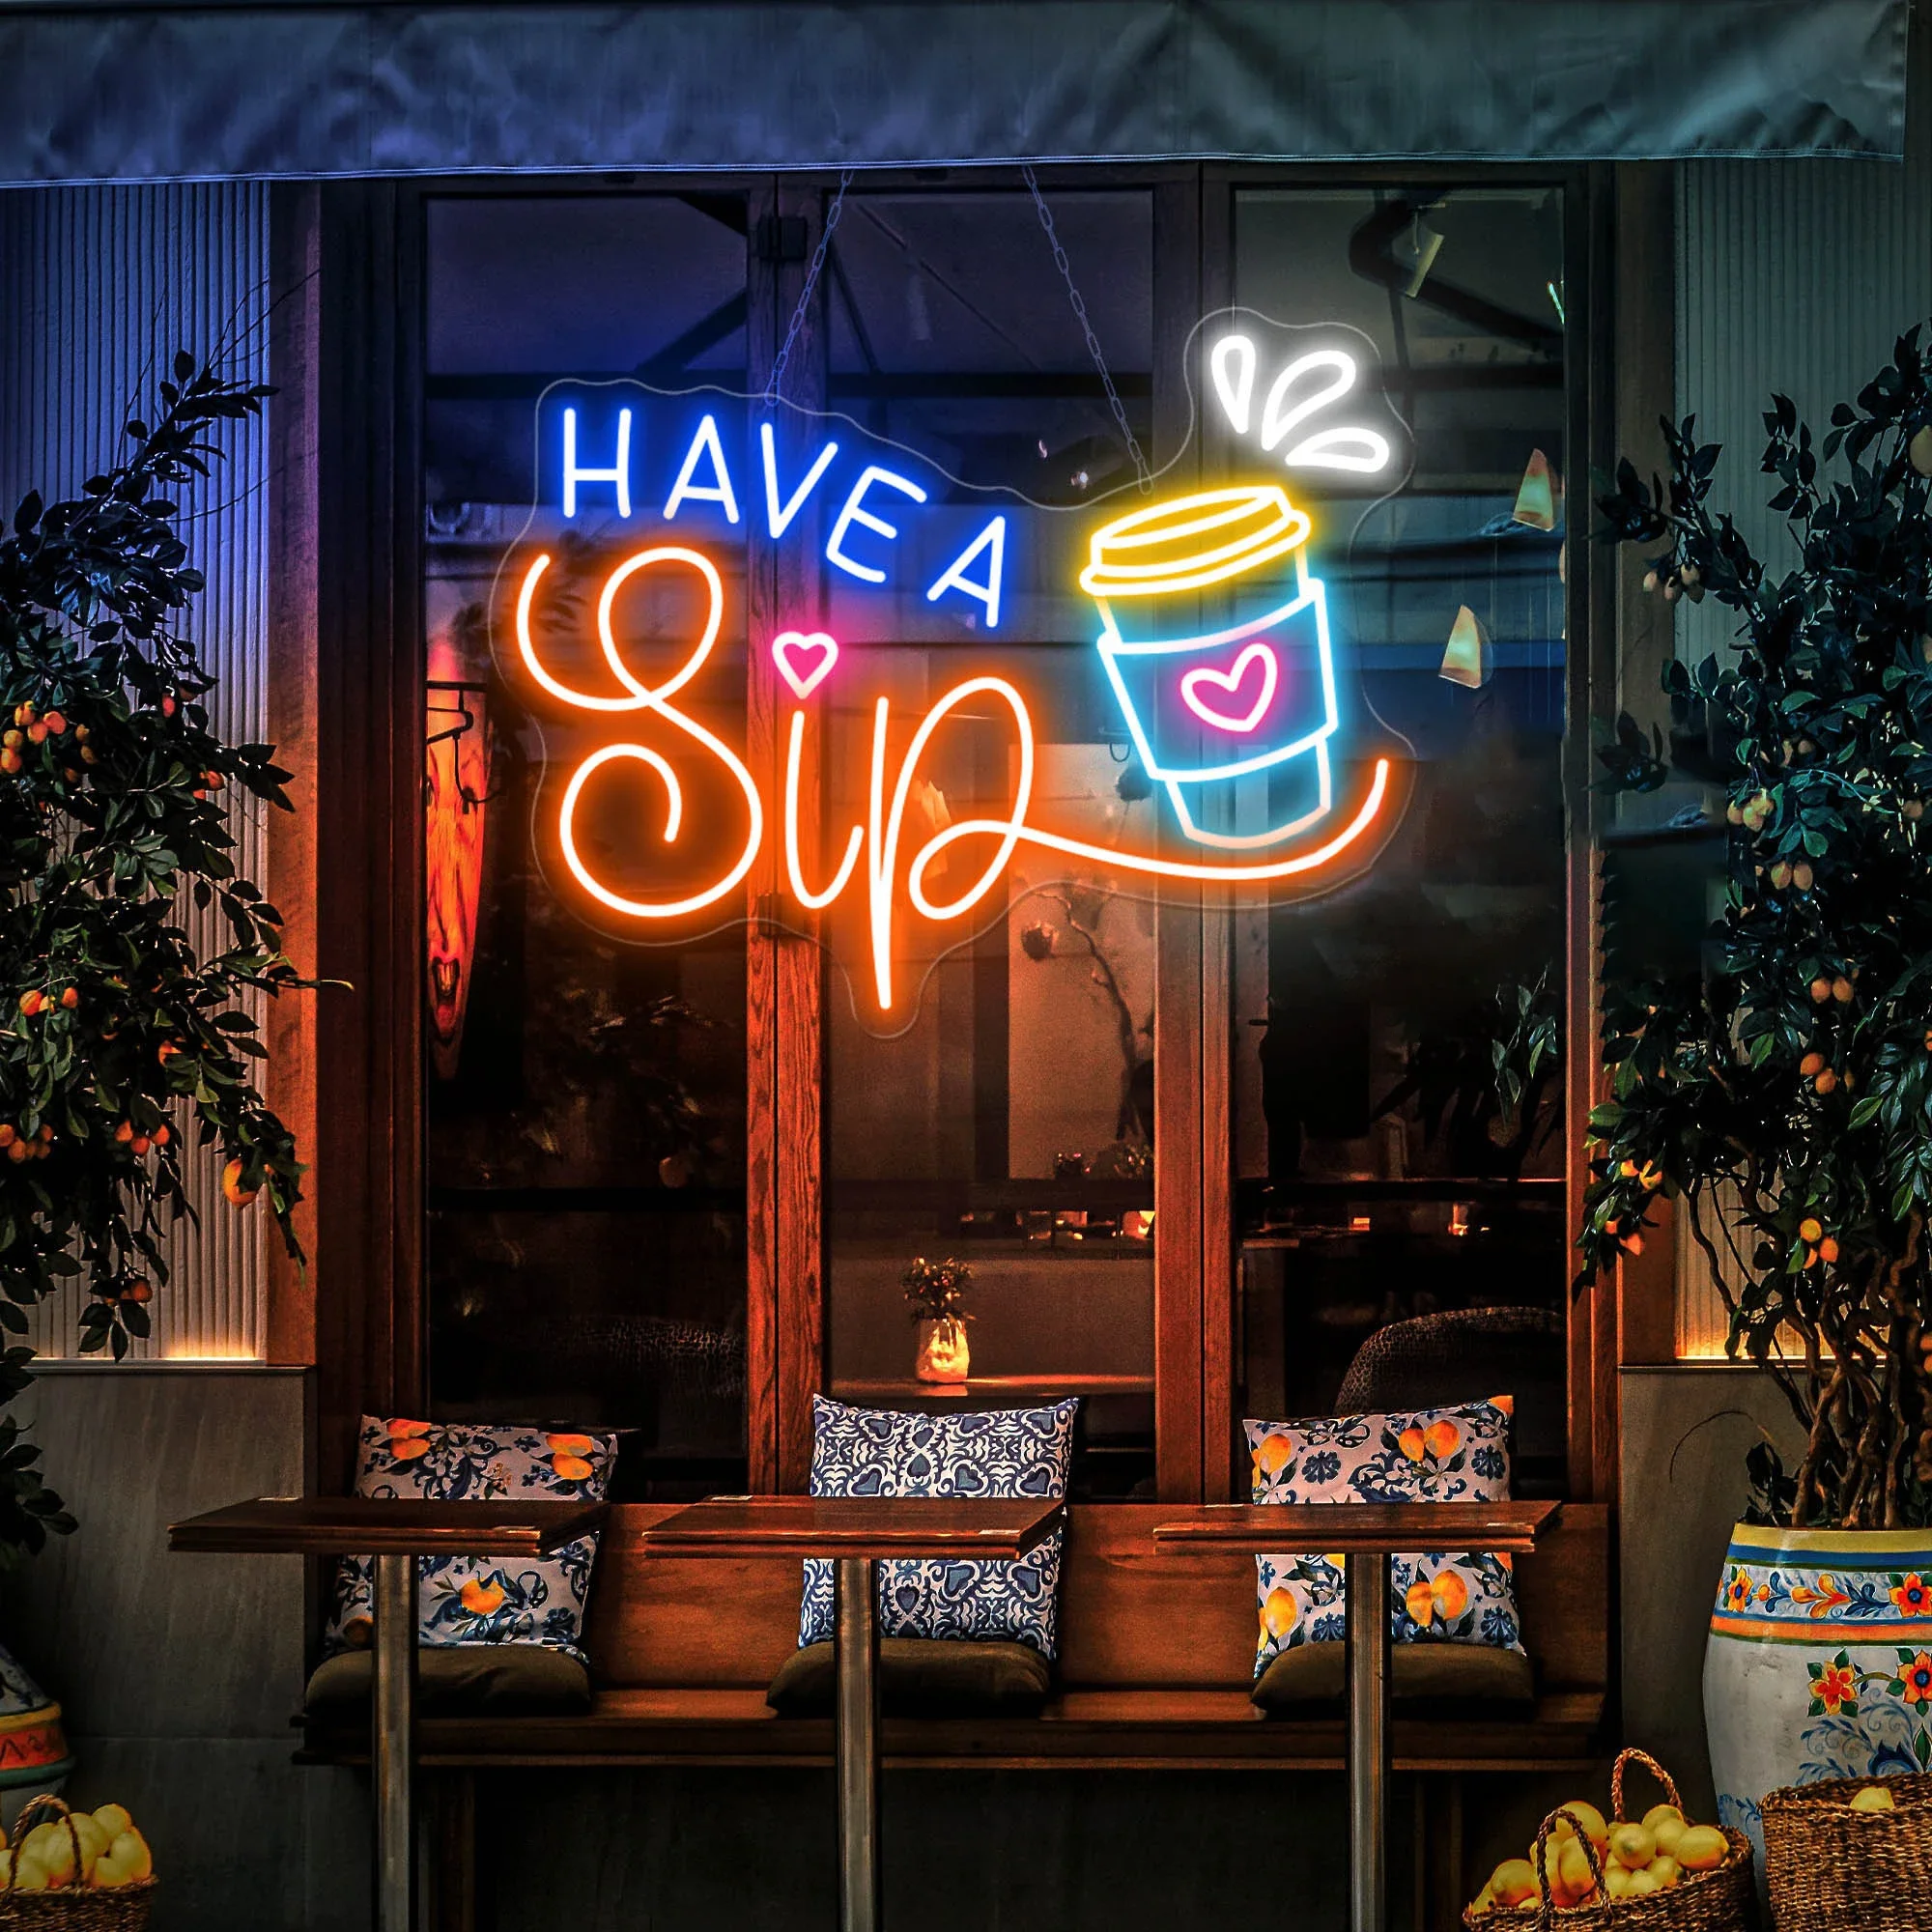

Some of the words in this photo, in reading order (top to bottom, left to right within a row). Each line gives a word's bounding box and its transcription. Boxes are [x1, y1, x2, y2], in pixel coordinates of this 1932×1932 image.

[562, 407, 927, 583] HAVE
[925, 515, 1007, 629] A
[516, 546, 1390, 1010] Sip
